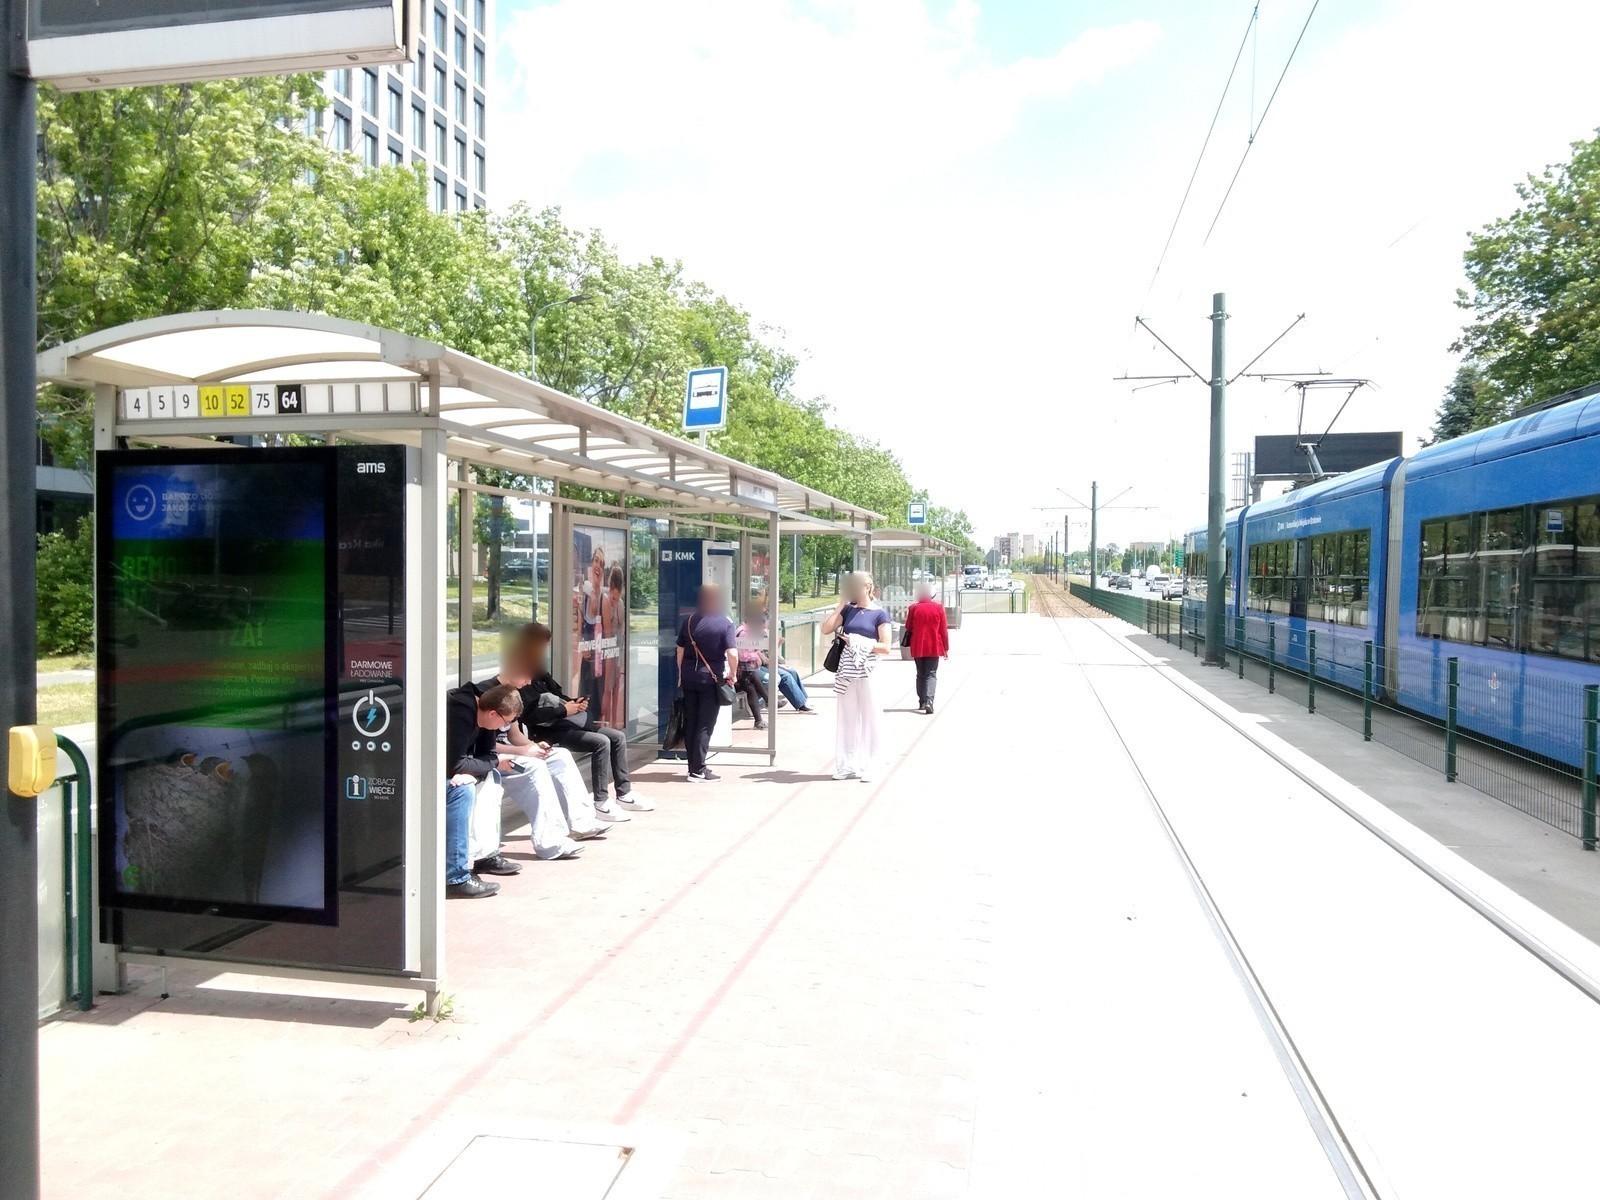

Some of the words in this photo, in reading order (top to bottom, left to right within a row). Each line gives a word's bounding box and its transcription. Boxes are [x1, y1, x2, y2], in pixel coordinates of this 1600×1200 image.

[133, 397, 141, 412] 4
[158, 395, 166, 410] 5
[182, 393, 190, 409] 9
[205, 394, 219, 410] 10
[230, 394, 245, 409] 52
[256, 393, 270, 409] 75
[281, 391, 298, 408] 64
[357, 462, 386, 474] ams
[675, 551, 696, 561] KMK
[351, 660, 393, 670] DARMOWE
